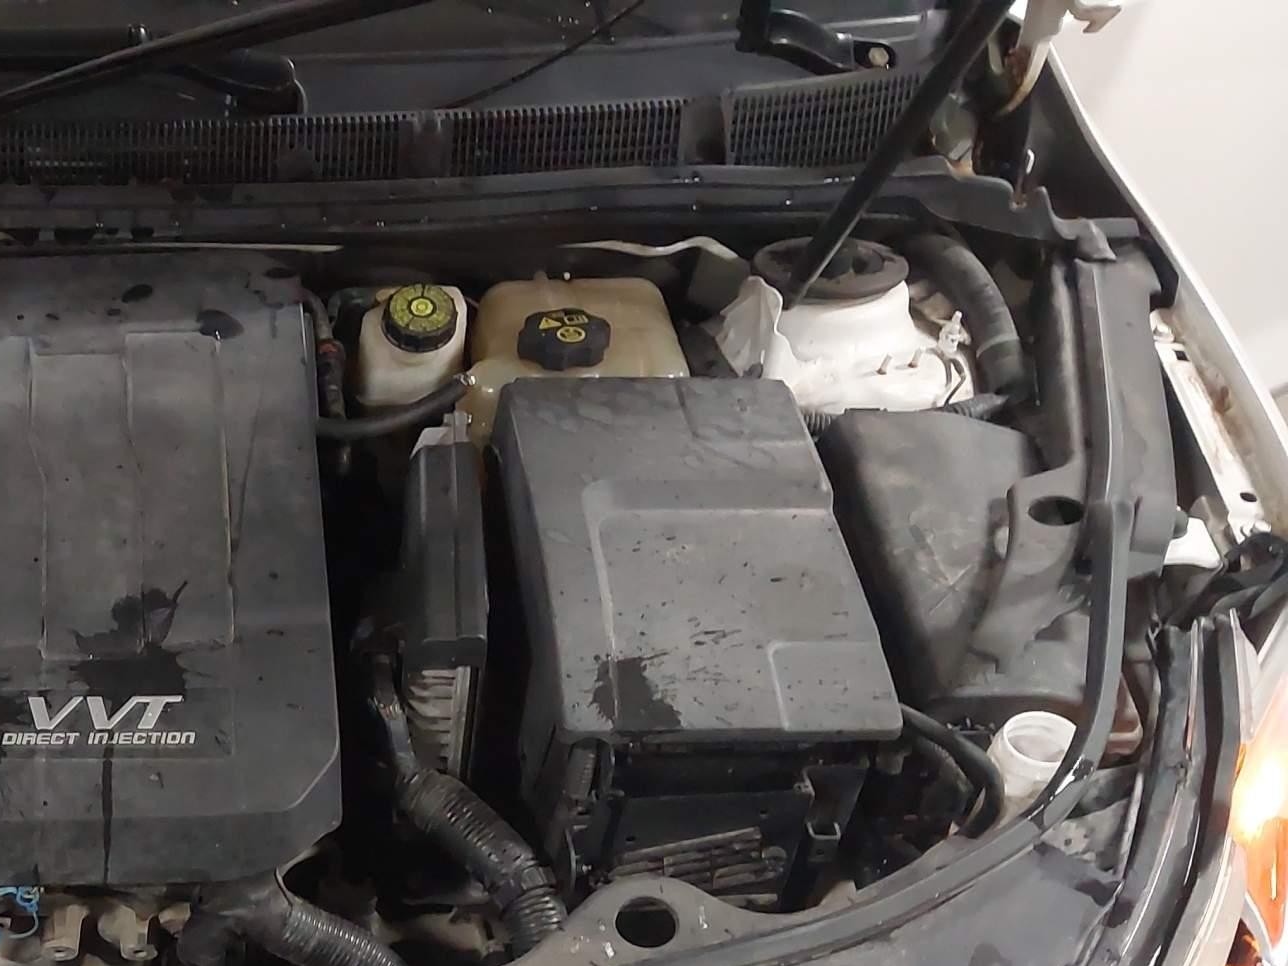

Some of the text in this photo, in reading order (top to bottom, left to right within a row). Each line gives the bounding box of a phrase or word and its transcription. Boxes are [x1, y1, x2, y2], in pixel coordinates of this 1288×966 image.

[27, 695, 184, 731] VVT
[2, 731, 197, 746] DIRECT INJECTION
